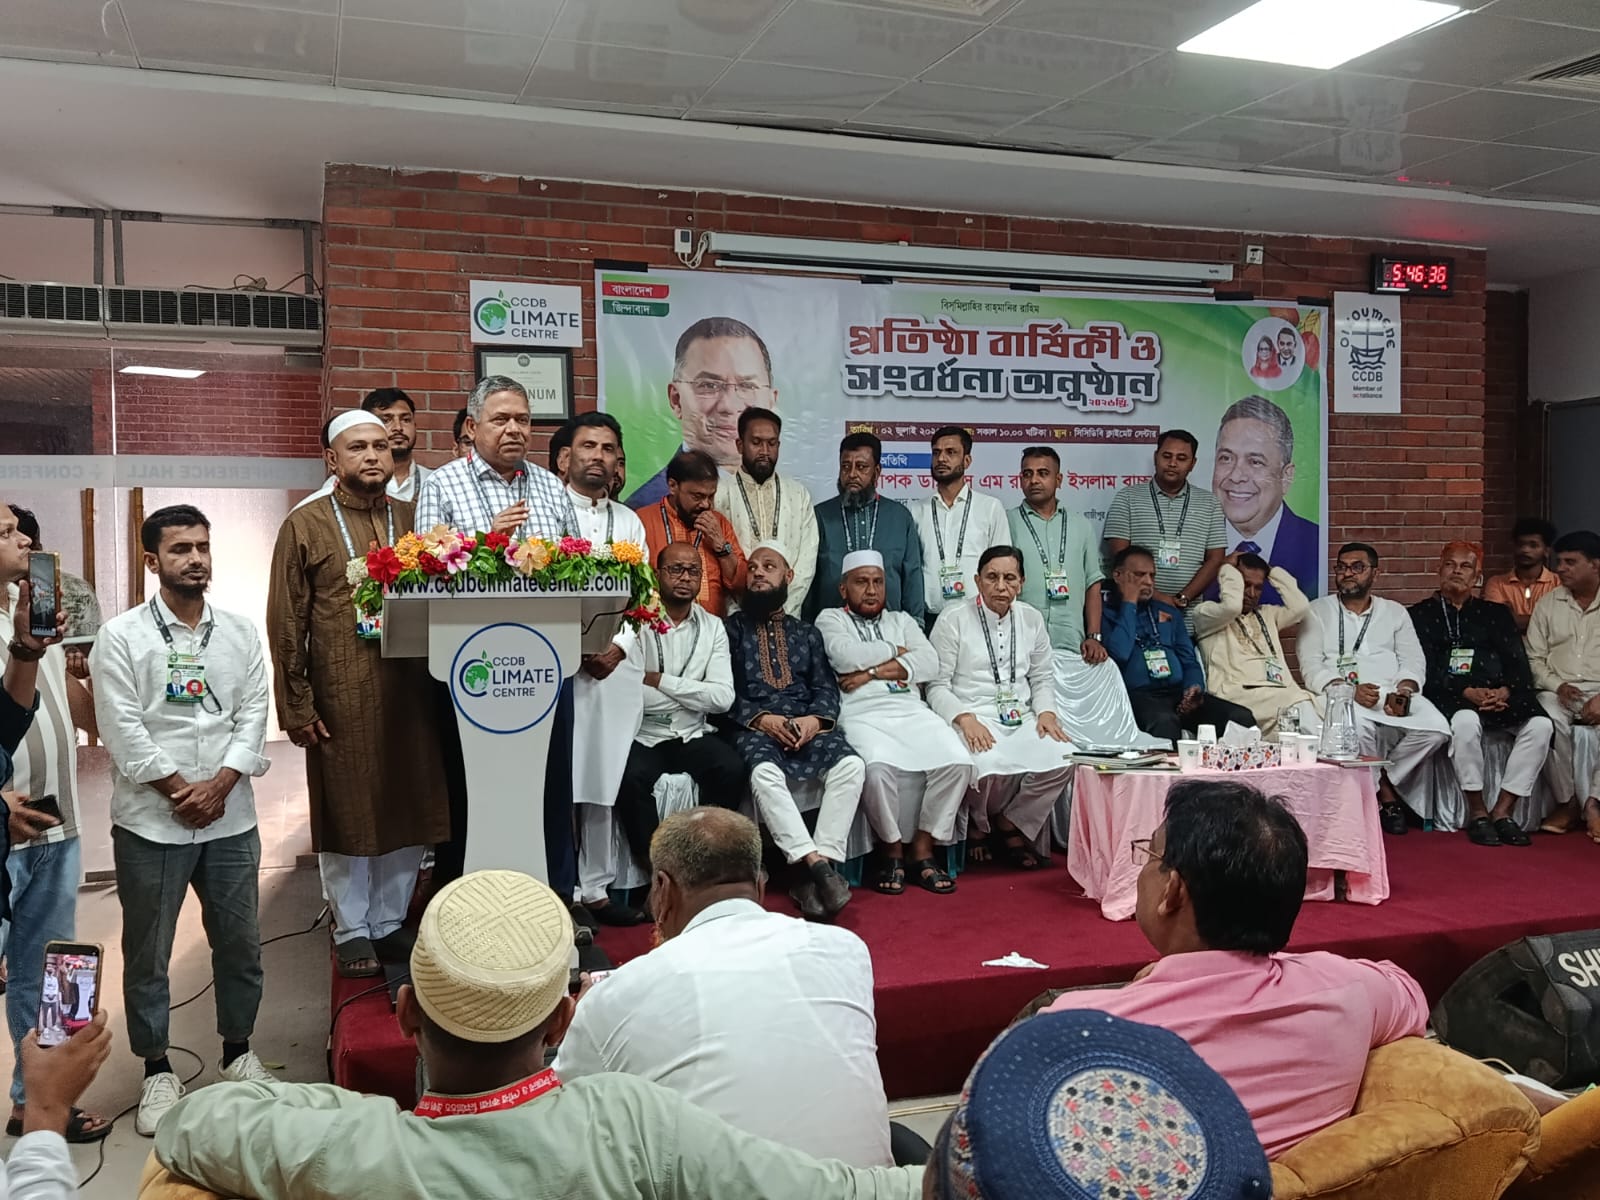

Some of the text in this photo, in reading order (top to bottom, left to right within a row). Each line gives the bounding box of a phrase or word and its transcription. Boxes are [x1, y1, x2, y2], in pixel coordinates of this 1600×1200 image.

[611, 284, 653, 296] বাংলাদেশ
[510, 297, 547, 308] CCDB
[612, 300, 650, 314] জিন্দাবাদ
[1019, 302, 1039, 313] রাহিম
[511, 328, 560, 339] CENTRE
[849, 318, 1156, 361] প্রতিষ্ঠা বার্ষিকী ও
[845, 356, 1155, 406] সংবর্ধনা অনুষ্ঠান
[1351, 370, 1384, 382] CCDB
[881, 427, 893, 435] ০২
[895, 425, 917, 437] জুলাই
[976, 427, 998, 437] সকাল
[1066, 470, 1118, 490] ইসলাম
[492, 656, 525, 667] CCDB
[492, 687, 535, 698] CENTRE
